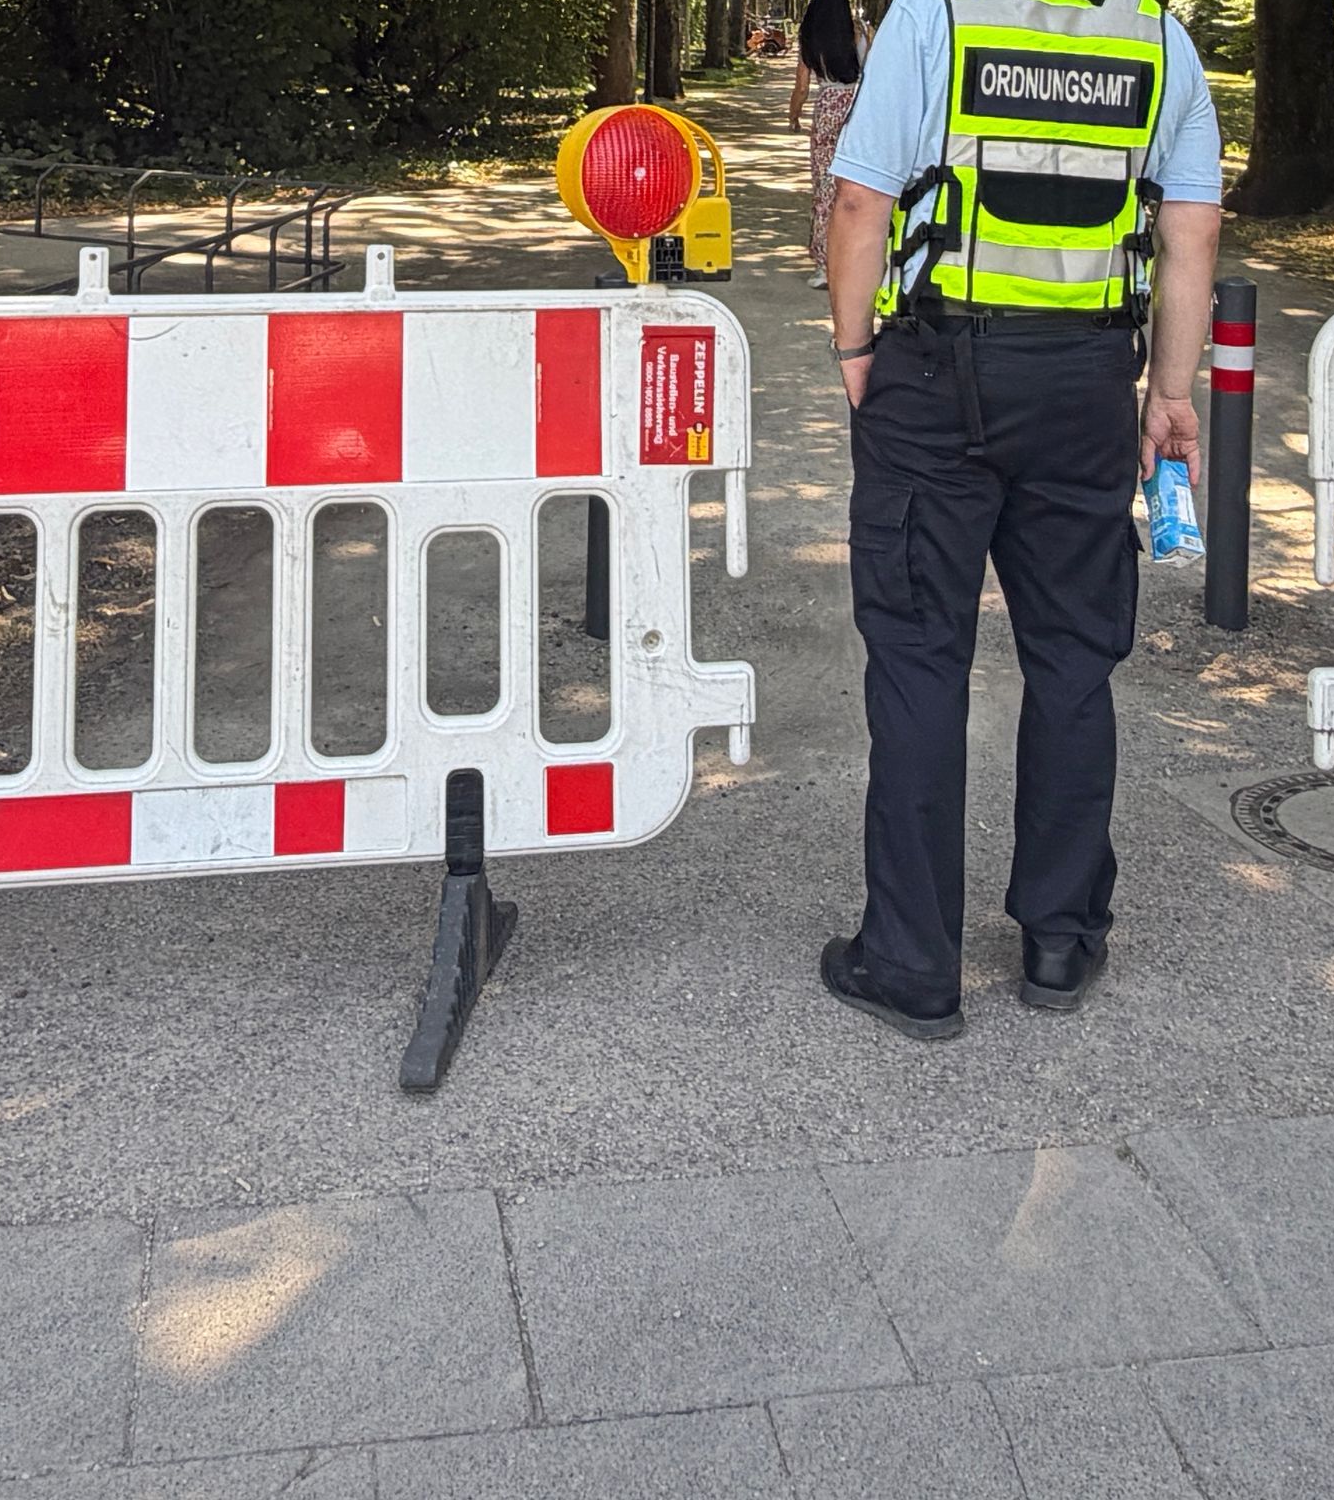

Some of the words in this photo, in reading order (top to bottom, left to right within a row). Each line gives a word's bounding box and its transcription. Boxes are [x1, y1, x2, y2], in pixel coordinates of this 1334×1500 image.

[980, 62, 1136, 108] ORDNUNGSAMT
[693, 340, 706, 414] ZEPPELIN
[668, 416, 677, 436] und
